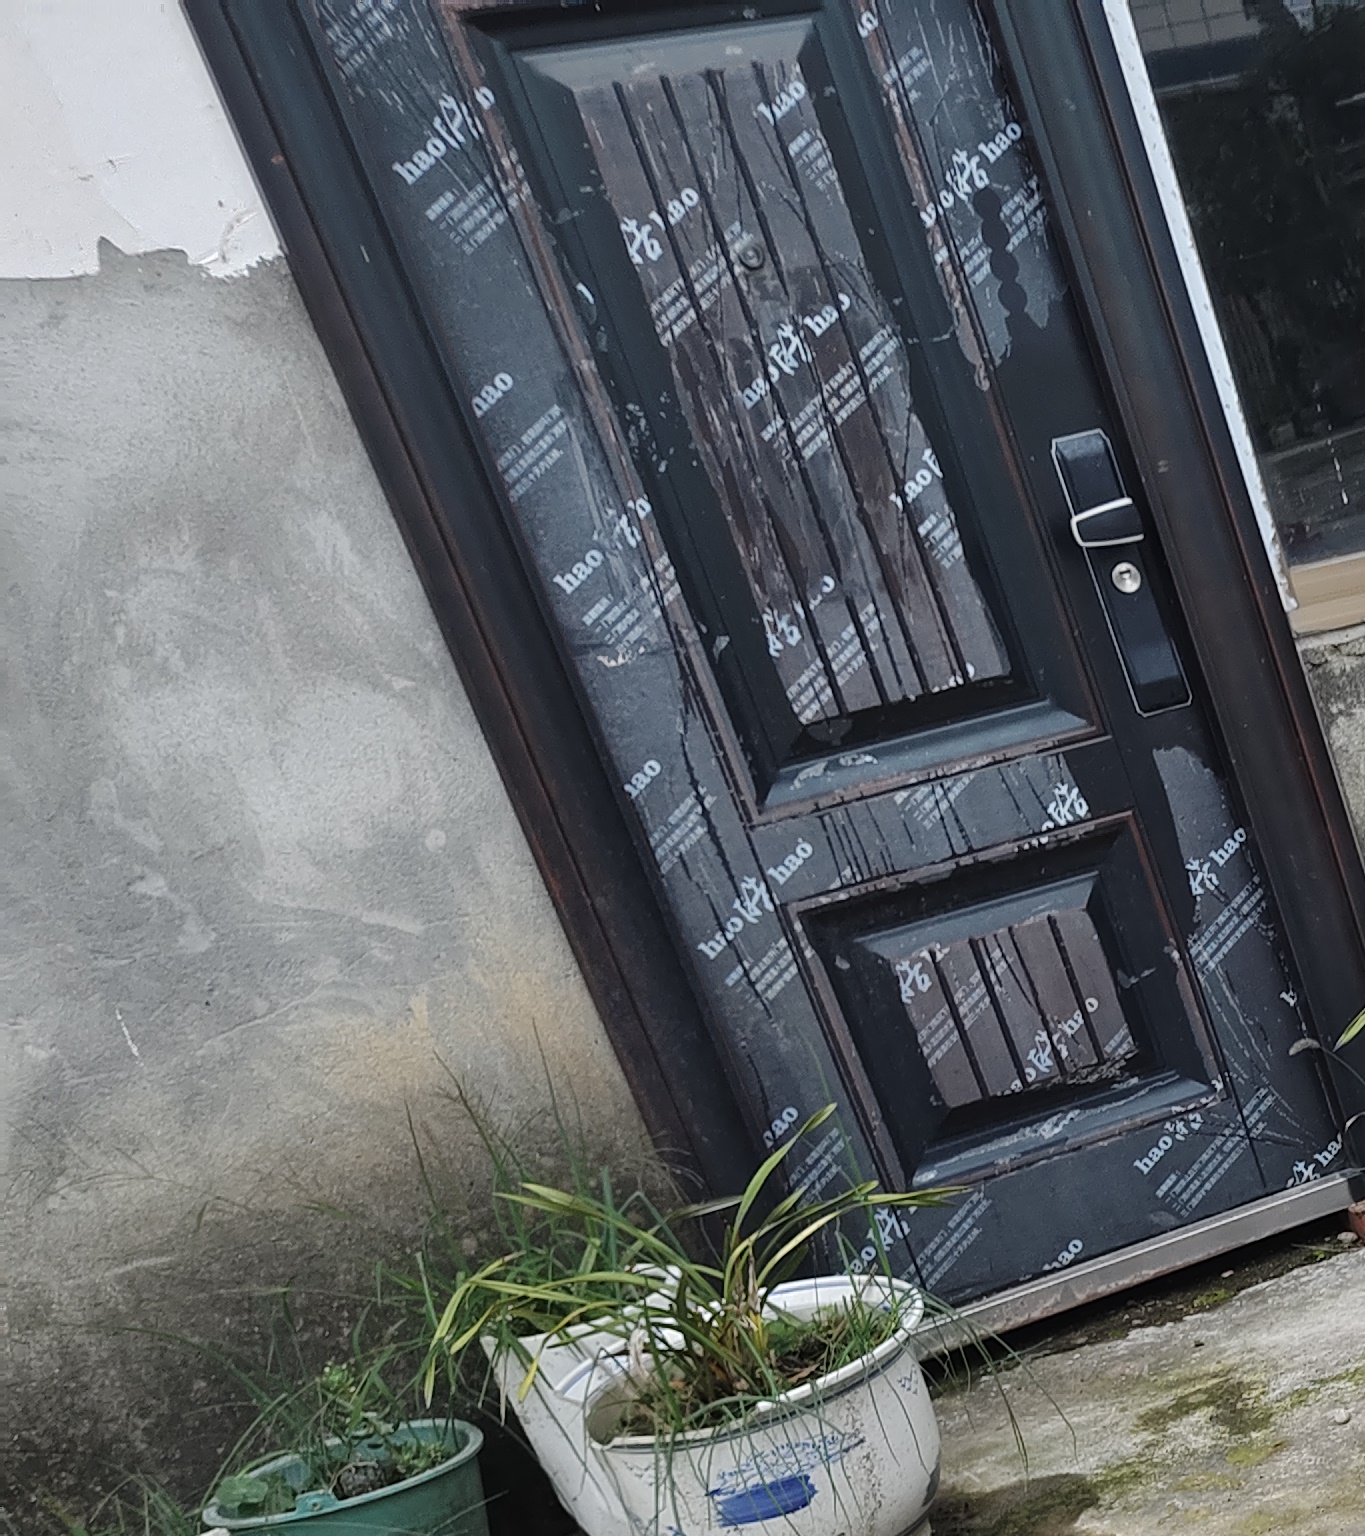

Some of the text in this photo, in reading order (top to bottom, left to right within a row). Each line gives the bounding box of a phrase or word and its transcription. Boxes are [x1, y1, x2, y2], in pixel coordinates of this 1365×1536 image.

[391, 140, 446, 185] hao
[978, 122, 1022, 162] hao
[552, 549, 604, 594] hao
[767, 840, 813, 886] hao
[1210, 827, 1246, 867] hao
[1134, 1136, 1173, 1174] hao
